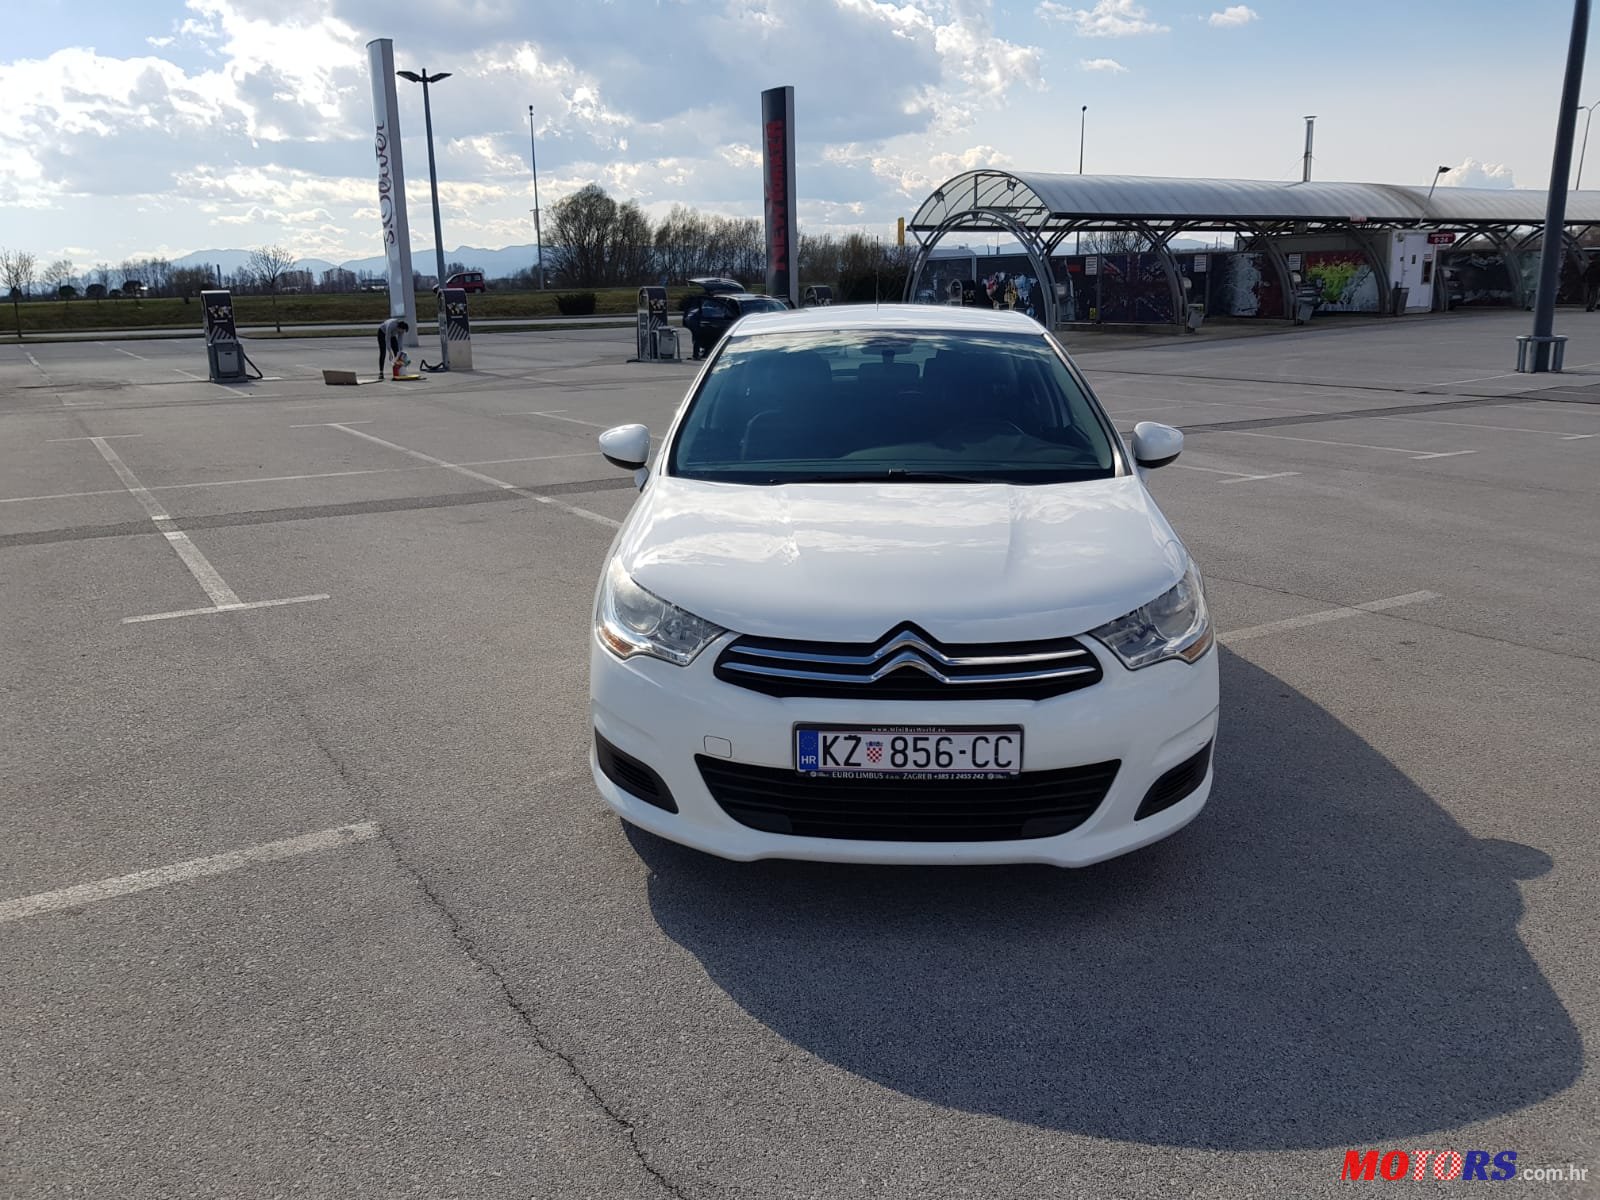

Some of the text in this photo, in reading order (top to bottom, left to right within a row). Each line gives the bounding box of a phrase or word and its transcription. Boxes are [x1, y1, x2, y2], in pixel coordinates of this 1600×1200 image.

[801, 755, 817, 765] HR
[832, 771, 854, 779] EURO
[855, 771, 884, 780] LIMBUS
[902, 772, 933, 781] ZAGREB
